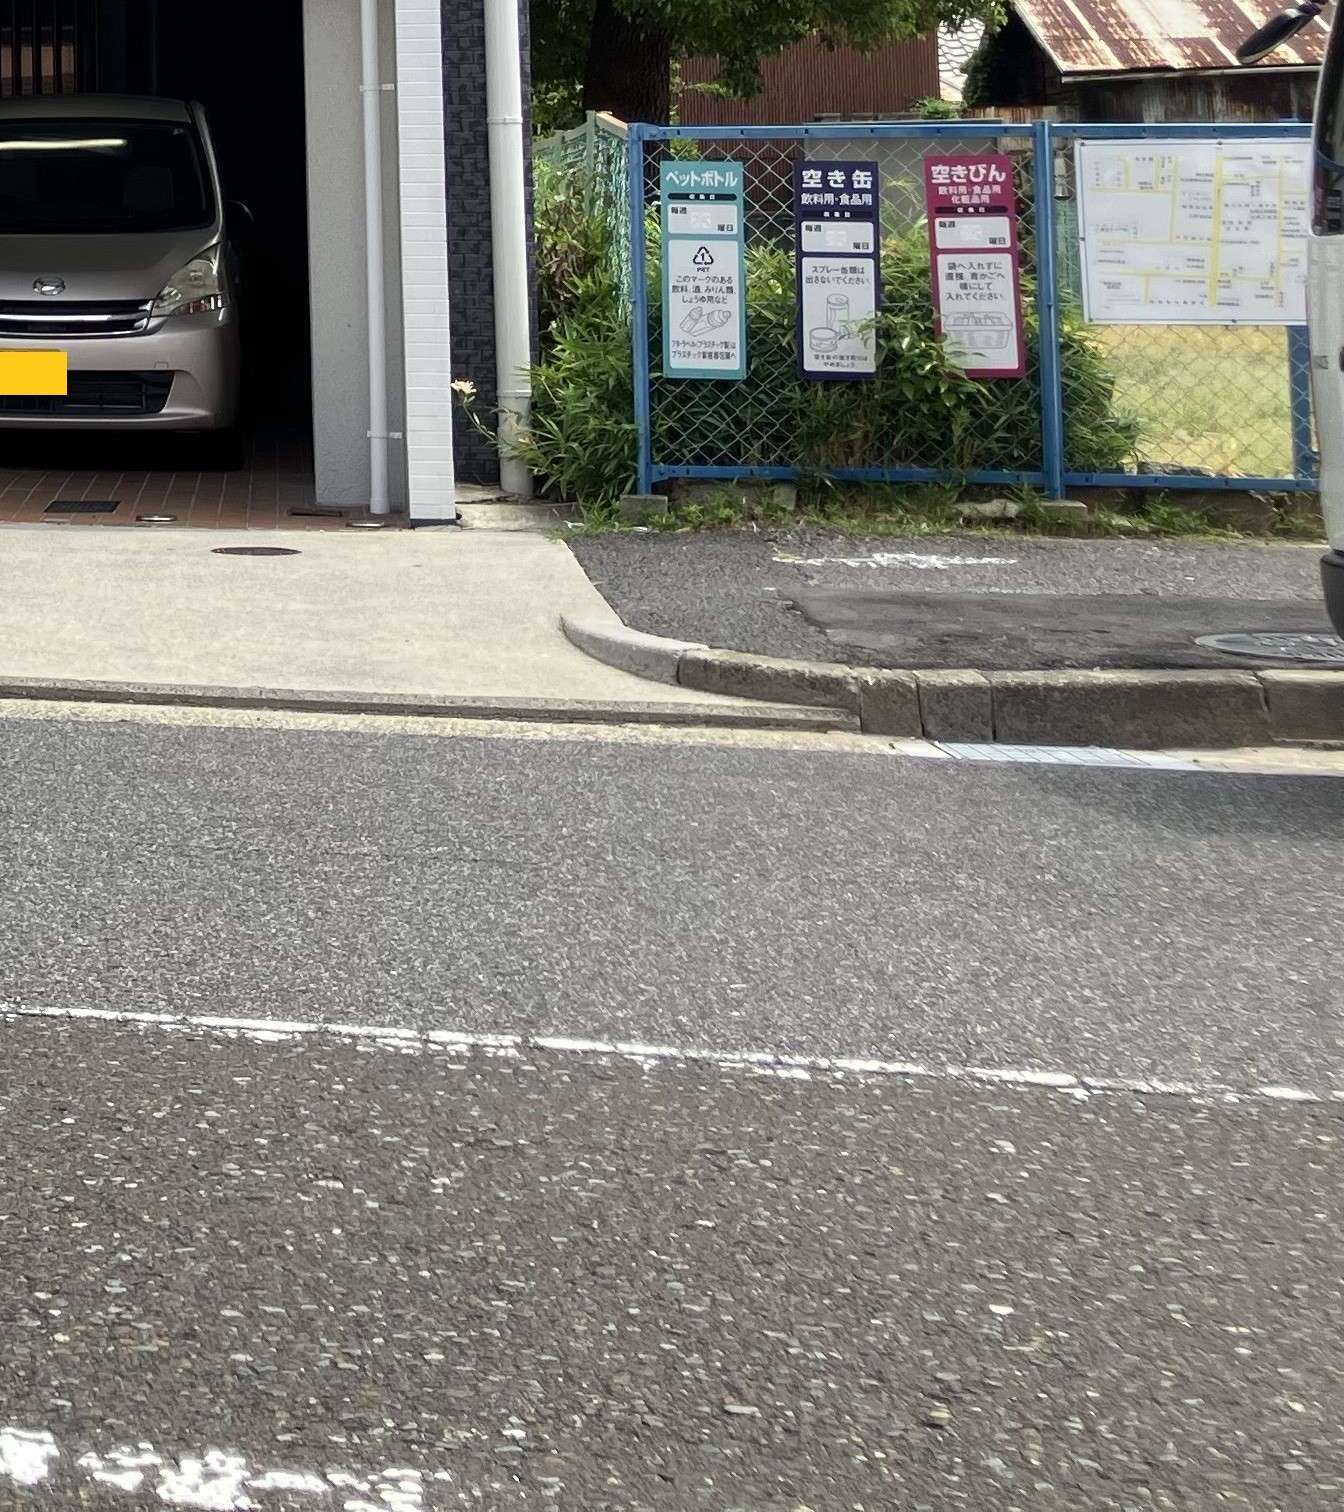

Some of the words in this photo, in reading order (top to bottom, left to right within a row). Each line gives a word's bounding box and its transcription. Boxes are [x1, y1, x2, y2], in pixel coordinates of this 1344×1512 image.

[666, 170, 738, 187] ペットボトル
[802, 169, 872, 188] 空き缶
[931, 164, 1006, 183] 空きびん
[676, 275, 733, 284] このマークのある
